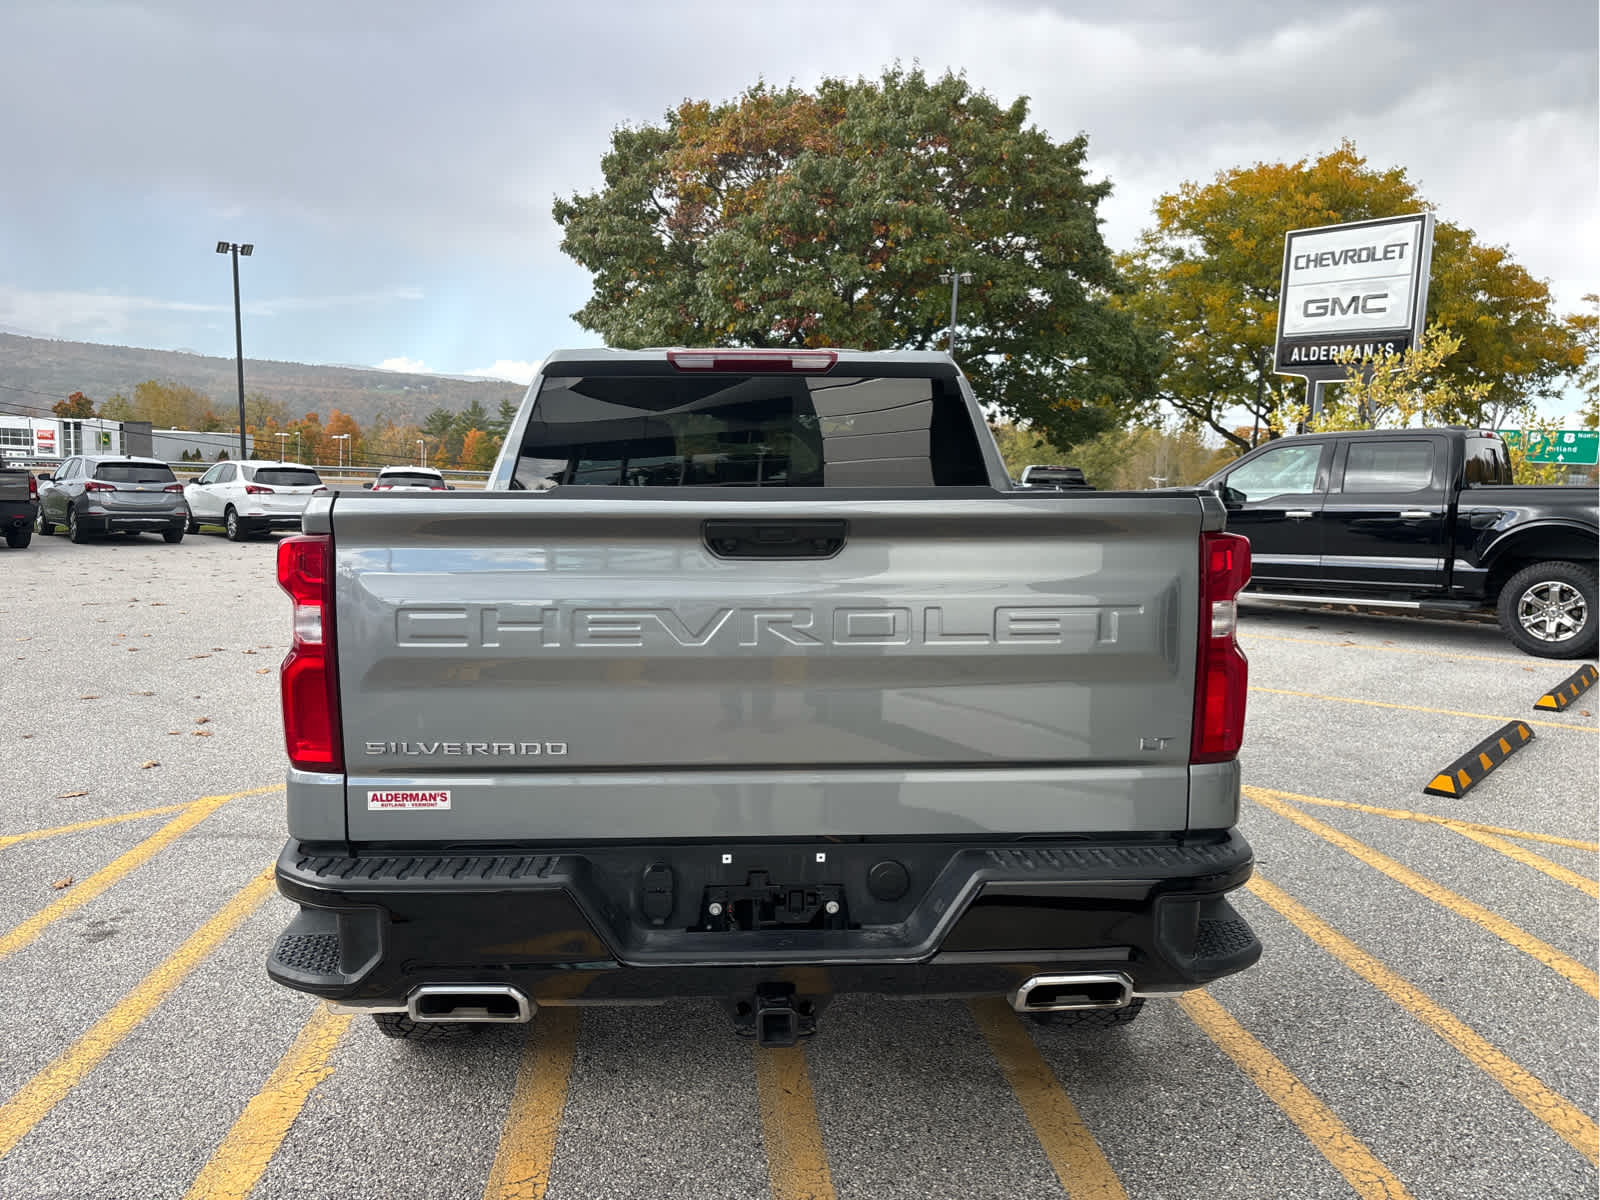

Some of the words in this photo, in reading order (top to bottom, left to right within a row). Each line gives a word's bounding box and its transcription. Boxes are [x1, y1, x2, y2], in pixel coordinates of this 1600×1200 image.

[1294, 242, 1409, 270] CHEVROLET
[1303, 293, 1388, 318] GMC
[395, 605, 1145, 647] CHEVROLET
[365, 741, 569, 756] SILVERADO
[1138, 736, 1176, 751] LT
[371, 792, 448, 803] ALDERMAN'S
